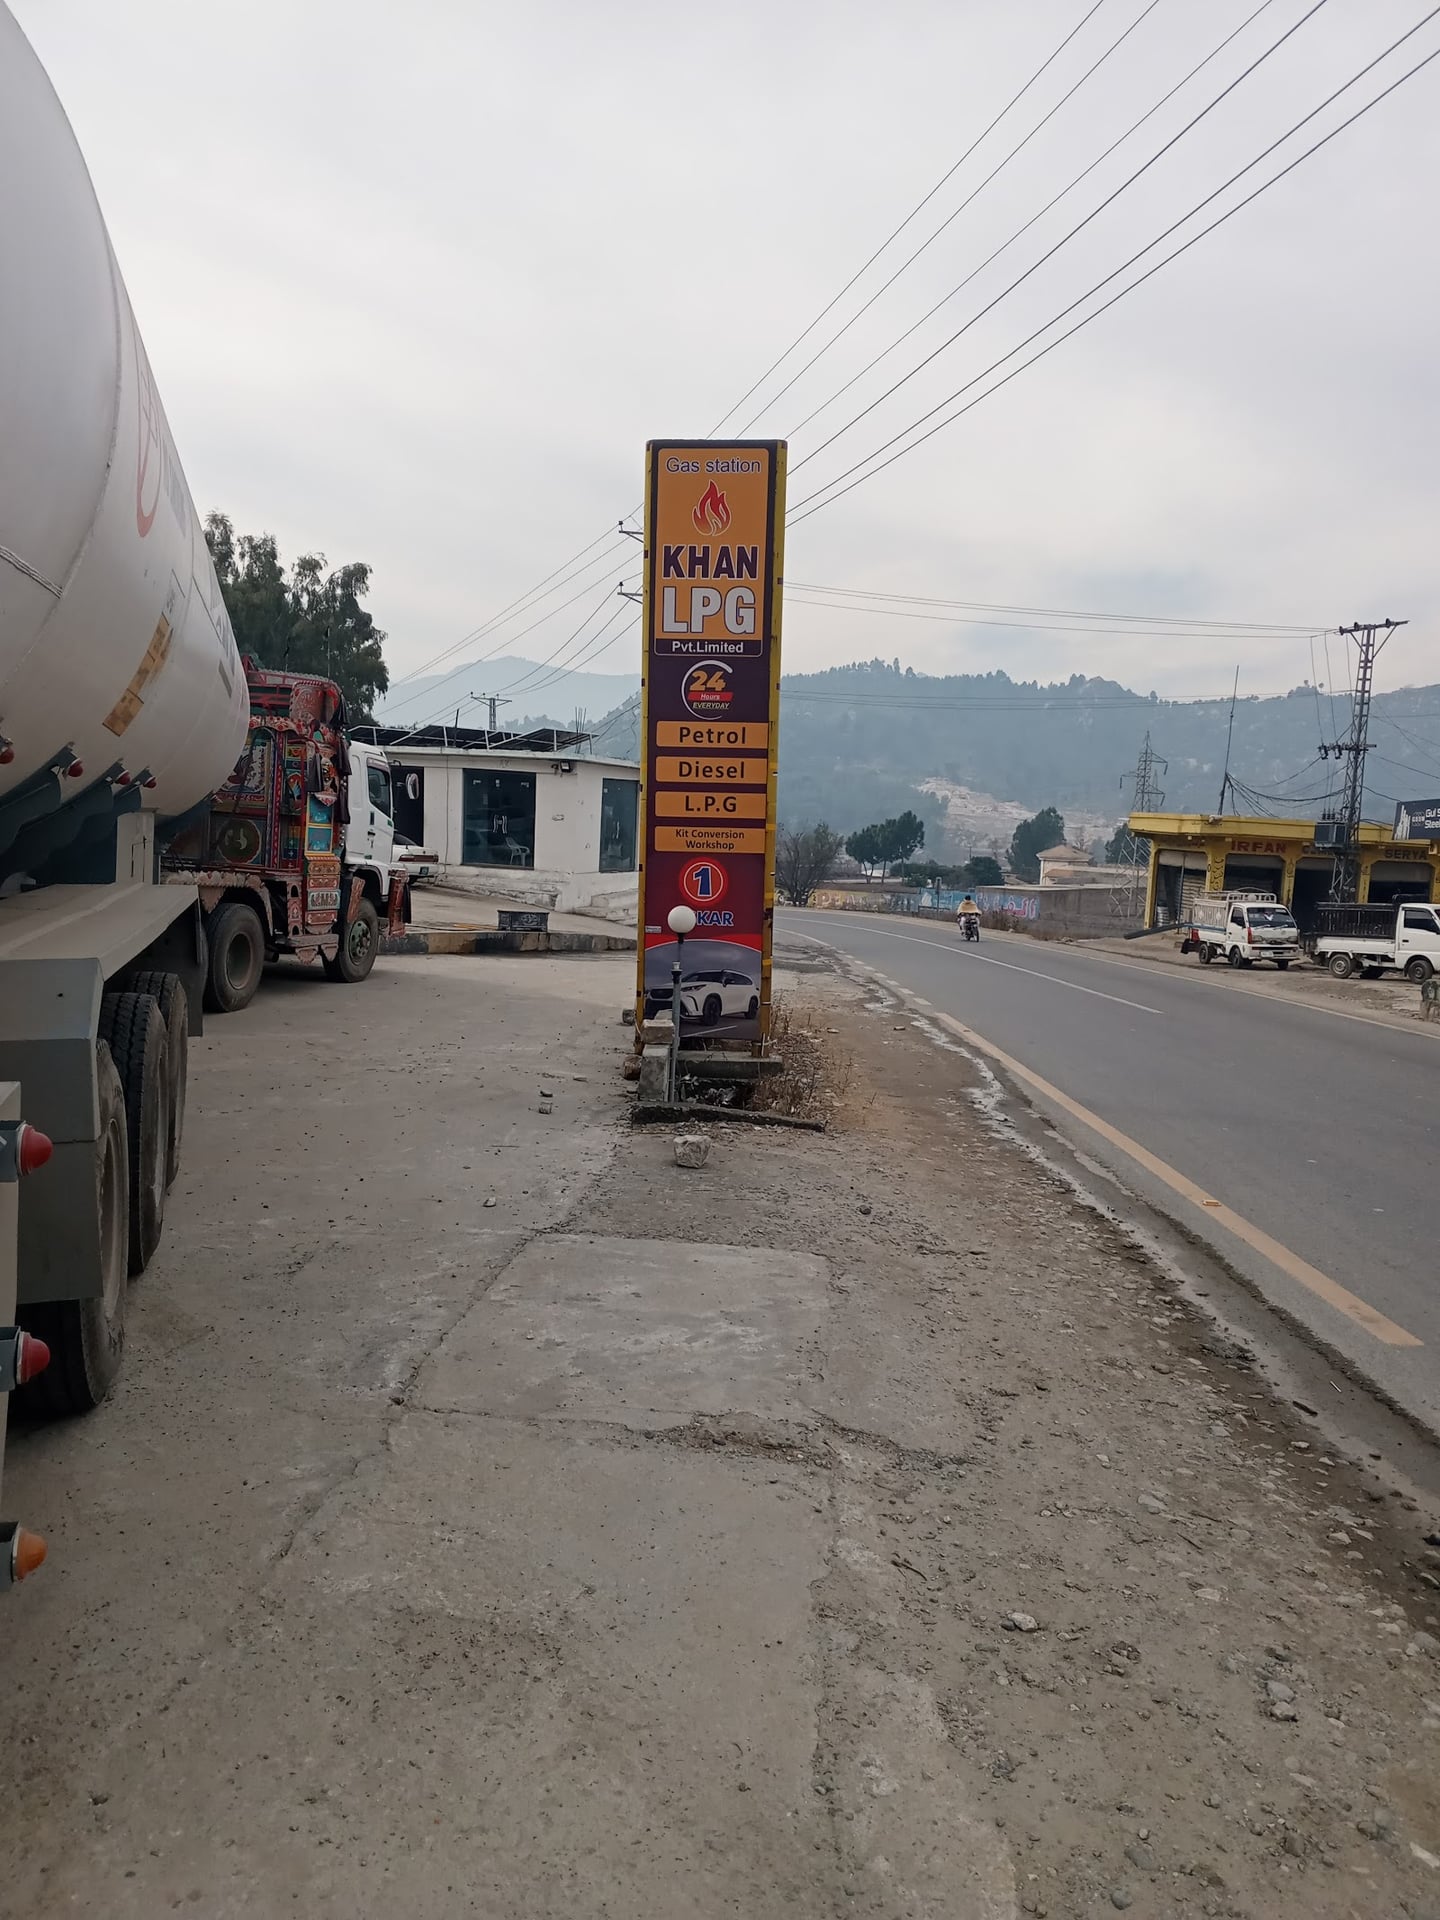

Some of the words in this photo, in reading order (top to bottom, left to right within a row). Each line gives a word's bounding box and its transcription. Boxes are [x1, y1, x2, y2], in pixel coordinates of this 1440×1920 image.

[666, 457, 700, 473] Gas
[705, 457, 761, 473] station
[662, 544, 759, 580] KHAN
[662, 586, 756, 635] LPG
[672, 640, 744, 654] Pvt.Limited
[690, 671, 726, 691] 24
[700, 693, 721, 701] Hours
[693, 702, 730, 710] EVERYDAY
[679, 726, 746, 745] Petrol
[679, 761, 745, 779] Diesel
[685, 795, 737, 812] L.P.G
[675, 829, 689, 838] Kit
[691, 829, 745, 839] Conversion
[686, 840, 735, 850] Workshop
[1231, 840, 1287, 853] IRFAN
[1384, 848, 1427, 860] SERYA
[693, 866, 711, 896] 1
